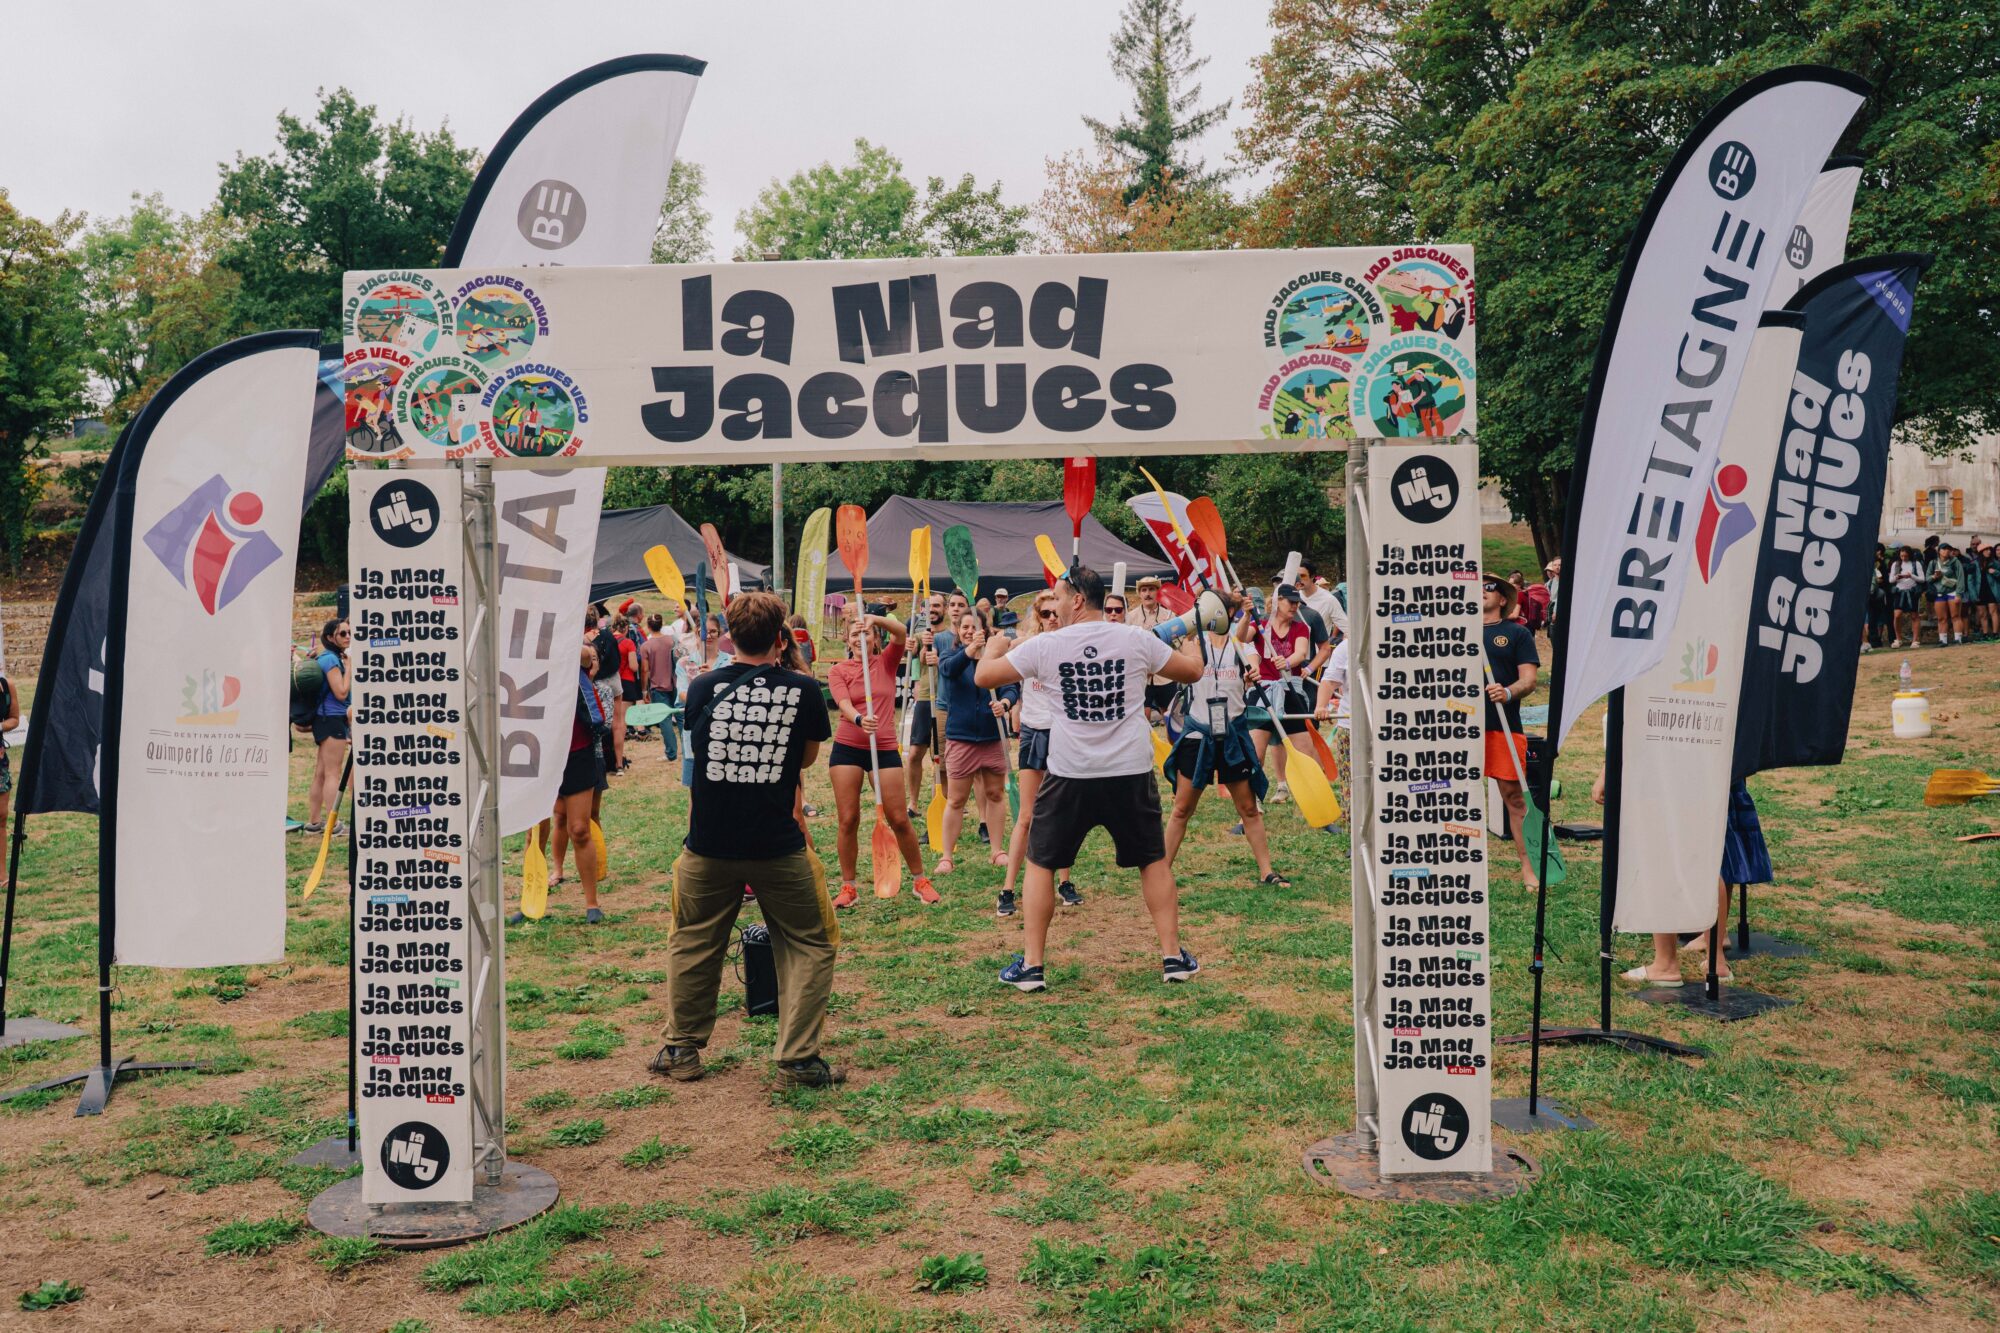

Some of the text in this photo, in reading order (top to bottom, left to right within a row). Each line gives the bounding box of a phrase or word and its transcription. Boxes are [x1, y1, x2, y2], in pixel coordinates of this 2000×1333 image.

[1716, 145, 1750, 196] BE
[531, 186, 573, 243] BE
[1790, 228, 1807, 266] BE
[1392, 247, 1469, 281] JACQUES
[343, 271, 454, 336] MAD JACQUES TREK
[457, 275, 549, 336] JACQUES CANOE
[1264, 271, 1384, 348] MAD JACQUES CANOE
[681, 273, 1109, 366] la Mad
[1258, 353, 1353, 411] MAD JACQUES
[1353, 335, 1476, 417] MAD JACQUES STOP
[397, 357, 460, 423] MAD JACQUES
[481, 363, 589, 424] MAD JACQUES VELO
[640, 362, 1177, 443] Jacques
[1611, 210, 1766, 641] BRETAGNE
[1758, 369, 1832, 652] la Mad
[1781, 348, 1872, 685] Jacques
[1382, 543, 1465, 562] la Mad
[360, 567, 445, 586] la Mad
[1375, 560, 1478, 577] Jacques
[1455, 572, 1476, 580] oulala
[353, 584, 458, 601] Jacques
[1383, 585, 1466, 603] la Mad
[361, 609, 446, 627] la Mad
[1375, 601, 1479, 618] Jacques
[1394, 614, 1420, 623] diantre
[353, 626, 459, 643] Jacques
[372, 639, 399, 647] diantre
[1384, 626, 1467, 644] la Mad
[362, 650, 447, 669] la Mad
[1376, 642, 1480, 659] Jacques
[354, 667, 460, 684] Jacques
[1058, 658, 1125, 678] staff
[1385, 667, 1467, 685] la Mad
[1060, 674, 1125, 694] staff
[1377, 684, 1480, 701] Jacques
[363, 692, 447, 710] la Mad
[713, 682, 802, 706] staff
[1062, 690, 1125, 709] staff
[355, 709, 460, 726] Jacques
[711, 700, 798, 725] staff
[1064, 706, 1126, 722] staff
[1385, 709, 1468, 727] la Mad
[1647, 708, 1702, 731] Quimperlé
[174, 732, 242, 740] DESTINATION
[709, 720, 791, 745] staff
[1377, 725, 1481, 742] Jacques
[363, 733, 447, 752] la Mad
[146, 741, 269, 765] Quimperlé les rias
[356, 750, 461, 767] Jacques
[707, 740, 788, 765] staff
[1386, 750, 1469, 768] la Mad
[225, 770, 244, 778] SUD
[706, 760, 784, 784] staff
[1378, 766, 1481, 783] Jacques
[364, 775, 449, 793] la Mad
[357, 792, 462, 809] Jacques
[1387, 791, 1469, 809] la Mad
[390, 808, 408, 818] doux
[1379, 807, 1482, 824] Jacques
[365, 816, 449, 835] la Mad
[358, 833, 462, 850] Jacques
[1387, 832, 1470, 850] la Mad
[1380, 849, 1483, 865] Jacques
[366, 858, 450, 876] la Mad
[358, 875, 463, 892] Jacques
[1388, 873, 1471, 892] la Mad
[1380, 890, 1484, 907] Jacques
[366, 900, 450, 918] la Mad
[359, 916, 463, 933] Jacques
[1389, 915, 1472, 933] la Mad
[1381, 931, 1485, 948] Jacques
[367, 941, 450, 959] la Mad
[359, 958, 463, 975] Jacques
[1390, 955, 1472, 974] la Mad
[1382, 972, 1486, 989] Jacques
[367, 982, 451, 1001] la Mad
[360, 999, 464, 1016] Jacques
[1390, 997, 1473, 1015] la Mad
[1382, 1013, 1486, 1030] Jacques
[368, 1024, 452, 1042] la Mad
[1396, 1028, 1419, 1036] fichtre
[360, 1041, 465, 1058] Jacques
[1391, 1037, 1474, 1055] la Mad
[374, 1055, 398, 1064] fichtre
[1383, 1054, 1486, 1071] Jacques
[369, 1065, 452, 1084] la Mad
[1458, 1066, 1472, 1074] bim
[361, 1082, 466, 1099] Jacques
[438, 1095, 452, 1103] bim
